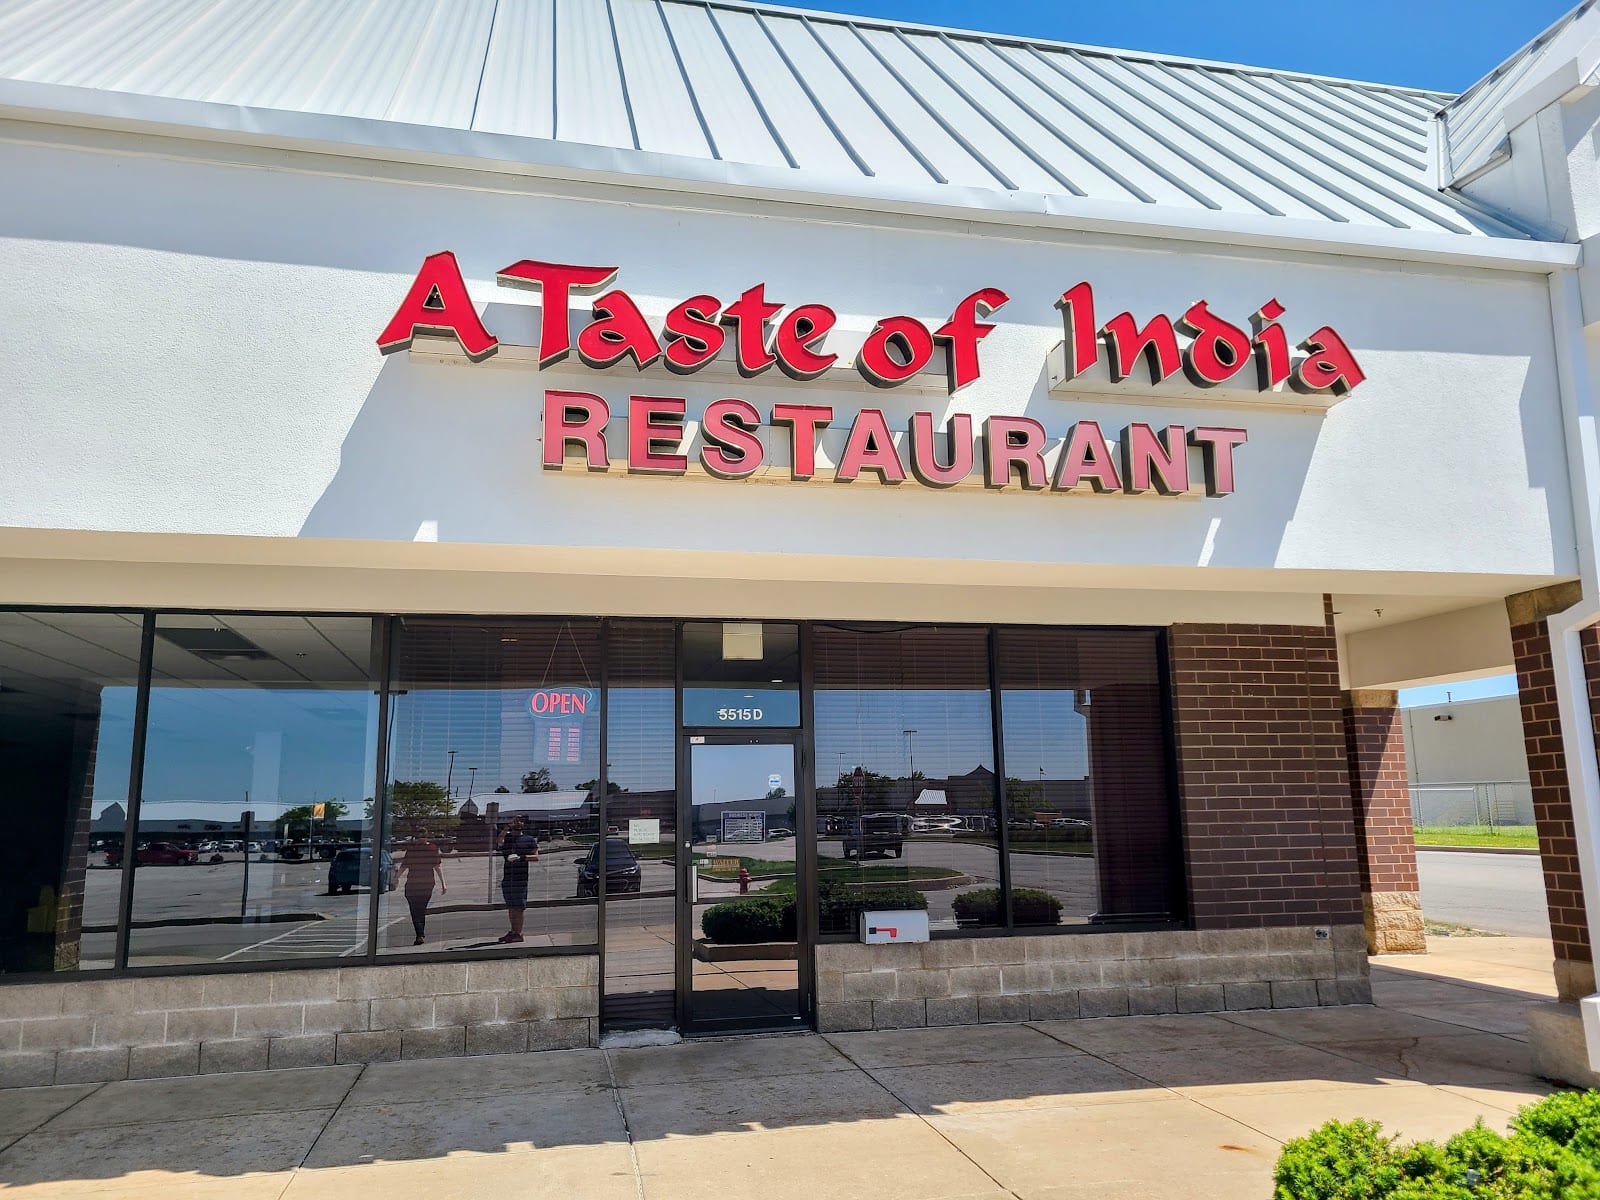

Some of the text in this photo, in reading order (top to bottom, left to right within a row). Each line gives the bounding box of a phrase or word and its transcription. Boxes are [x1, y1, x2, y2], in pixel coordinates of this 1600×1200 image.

[377, 250, 1366, 397] A Taste of India
[541, 388, 1248, 498] RESTAURANT
[531, 691, 587, 714] OPEN
